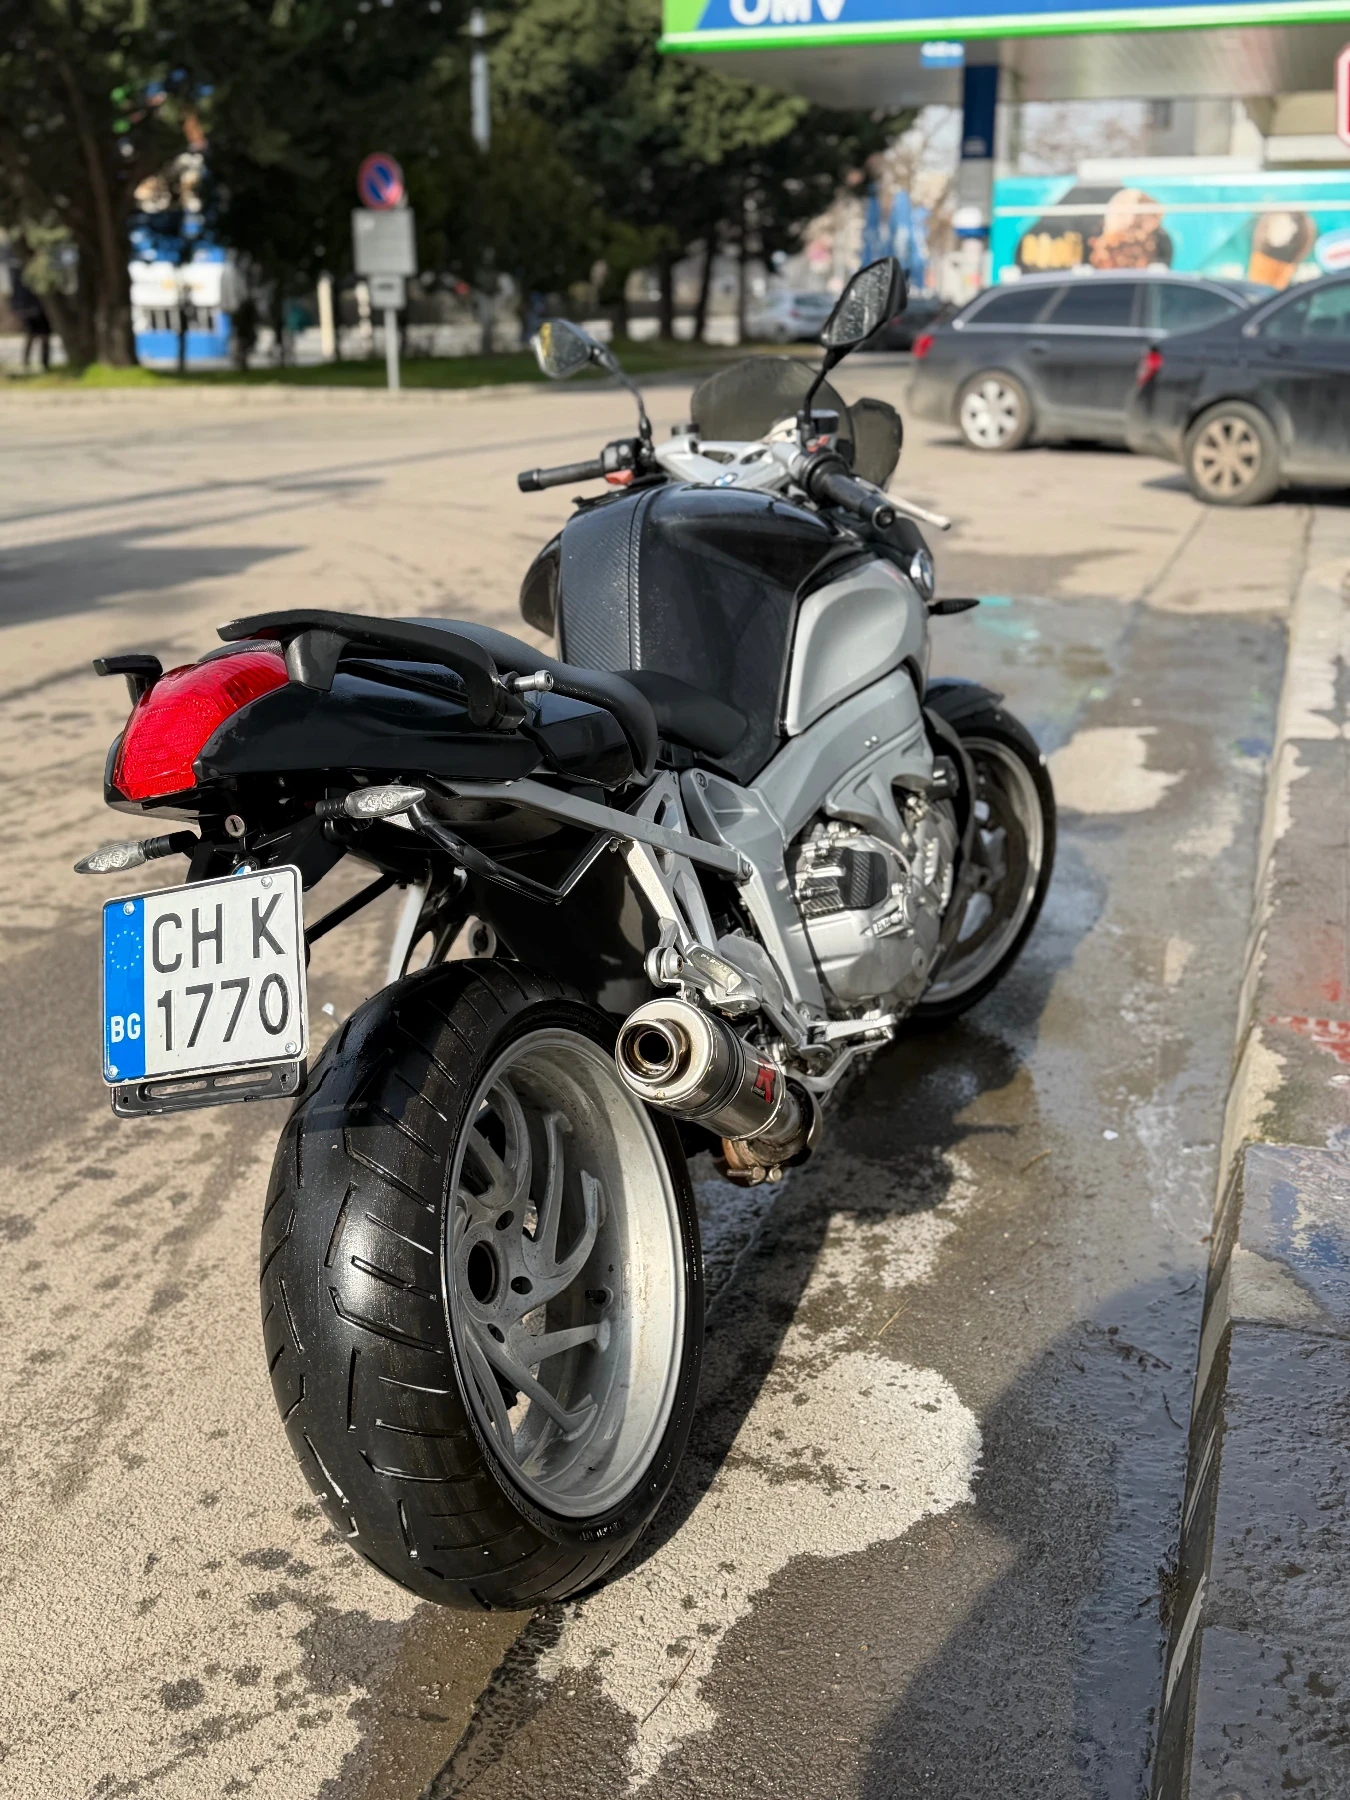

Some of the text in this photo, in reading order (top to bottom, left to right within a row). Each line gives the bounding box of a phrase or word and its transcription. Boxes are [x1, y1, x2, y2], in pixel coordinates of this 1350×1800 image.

[152, 893, 286, 974] CH K
[110, 1013, 142, 1043] BG
[157, 973, 290, 1051] 1770
